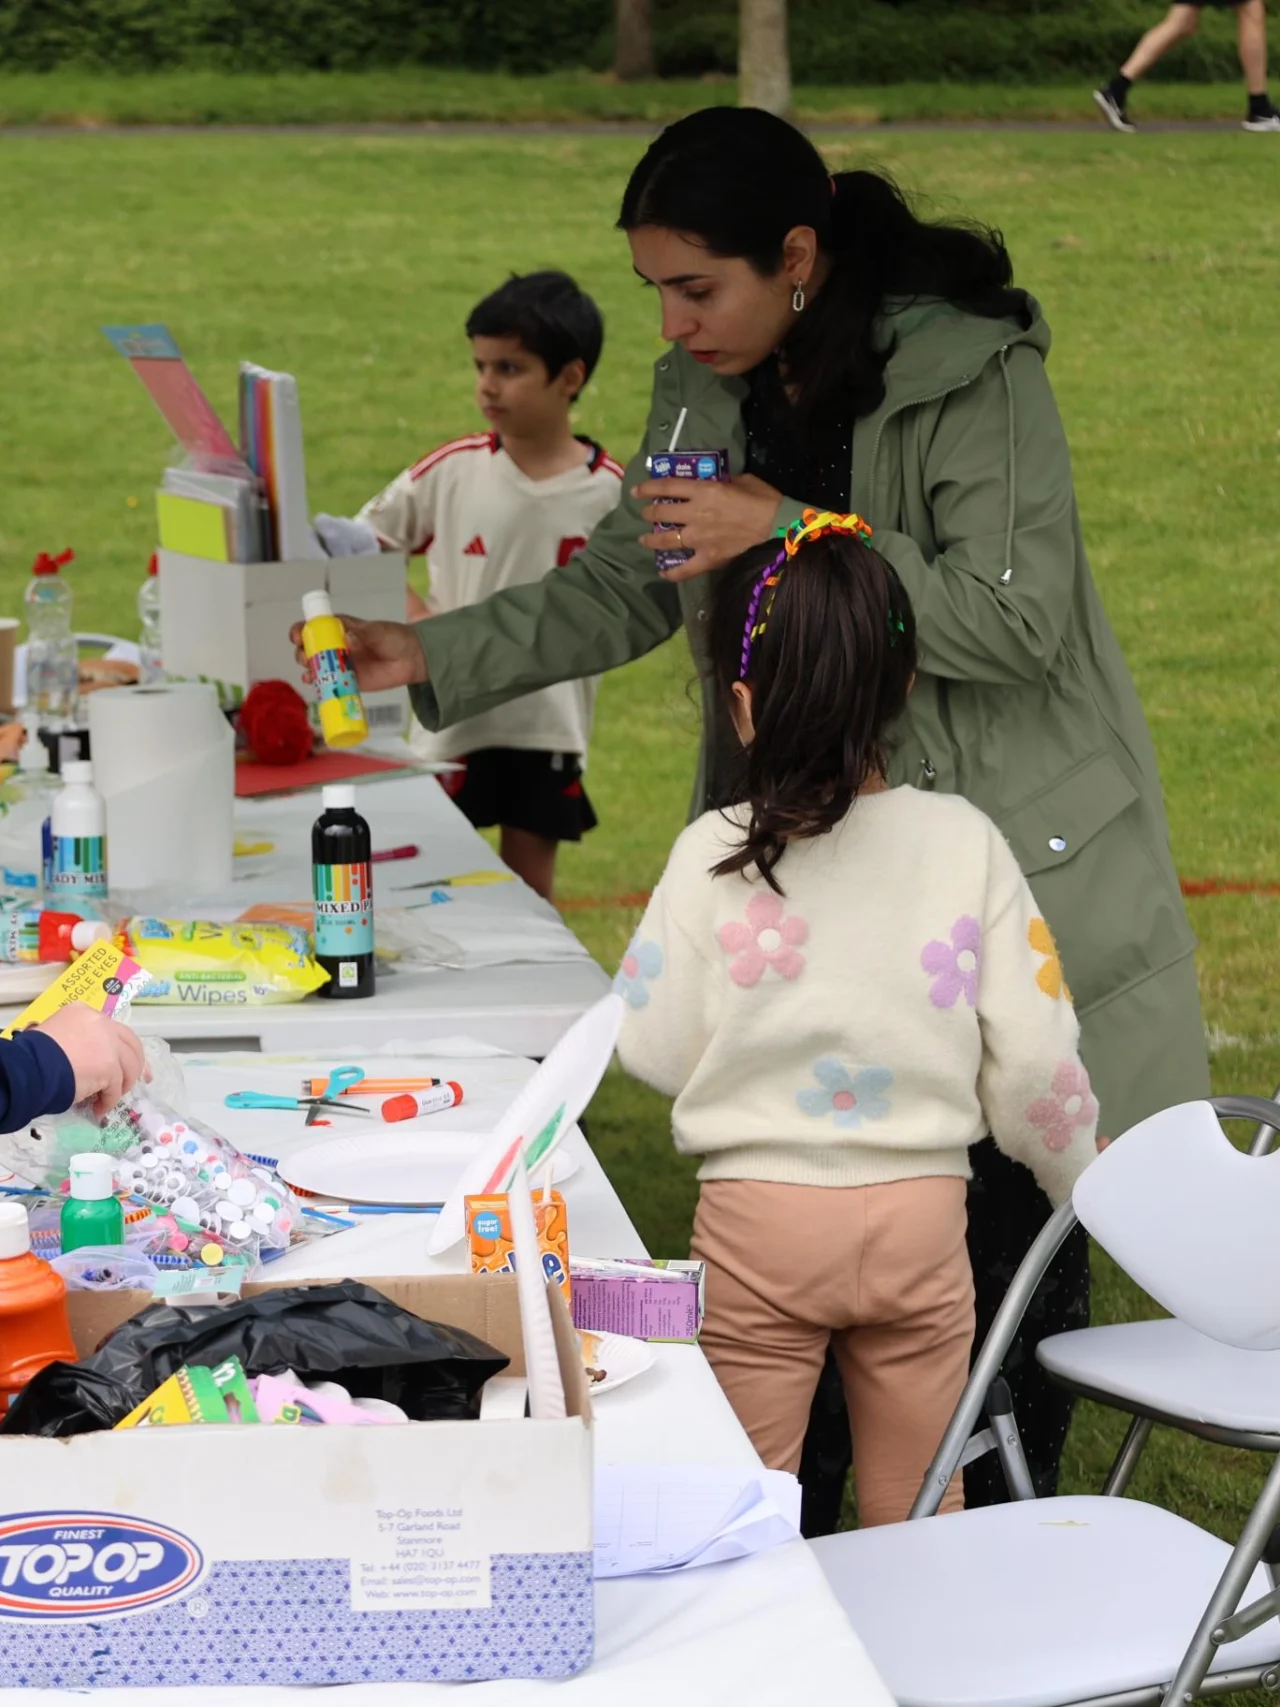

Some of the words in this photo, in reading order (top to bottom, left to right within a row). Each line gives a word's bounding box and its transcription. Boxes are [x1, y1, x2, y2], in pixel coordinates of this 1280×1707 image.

[316, 901, 360, 913] MIXED
[61, 947, 108, 992] ASSORTED
[96, 955, 118, 979] EYES
[177, 984, 247, 1006] Wipes
[477, 1225, 498, 1233] free!
[376, 1508, 413, 1519] Top-Op
[415, 1508, 444, 1518] Foods
[446, 1508, 464, 1517] Ltd
[436, 1521, 462, 1531] Road
[53, 1529, 106, 1541] FINEST
[49, 1585, 114, 1598] QUALITY
